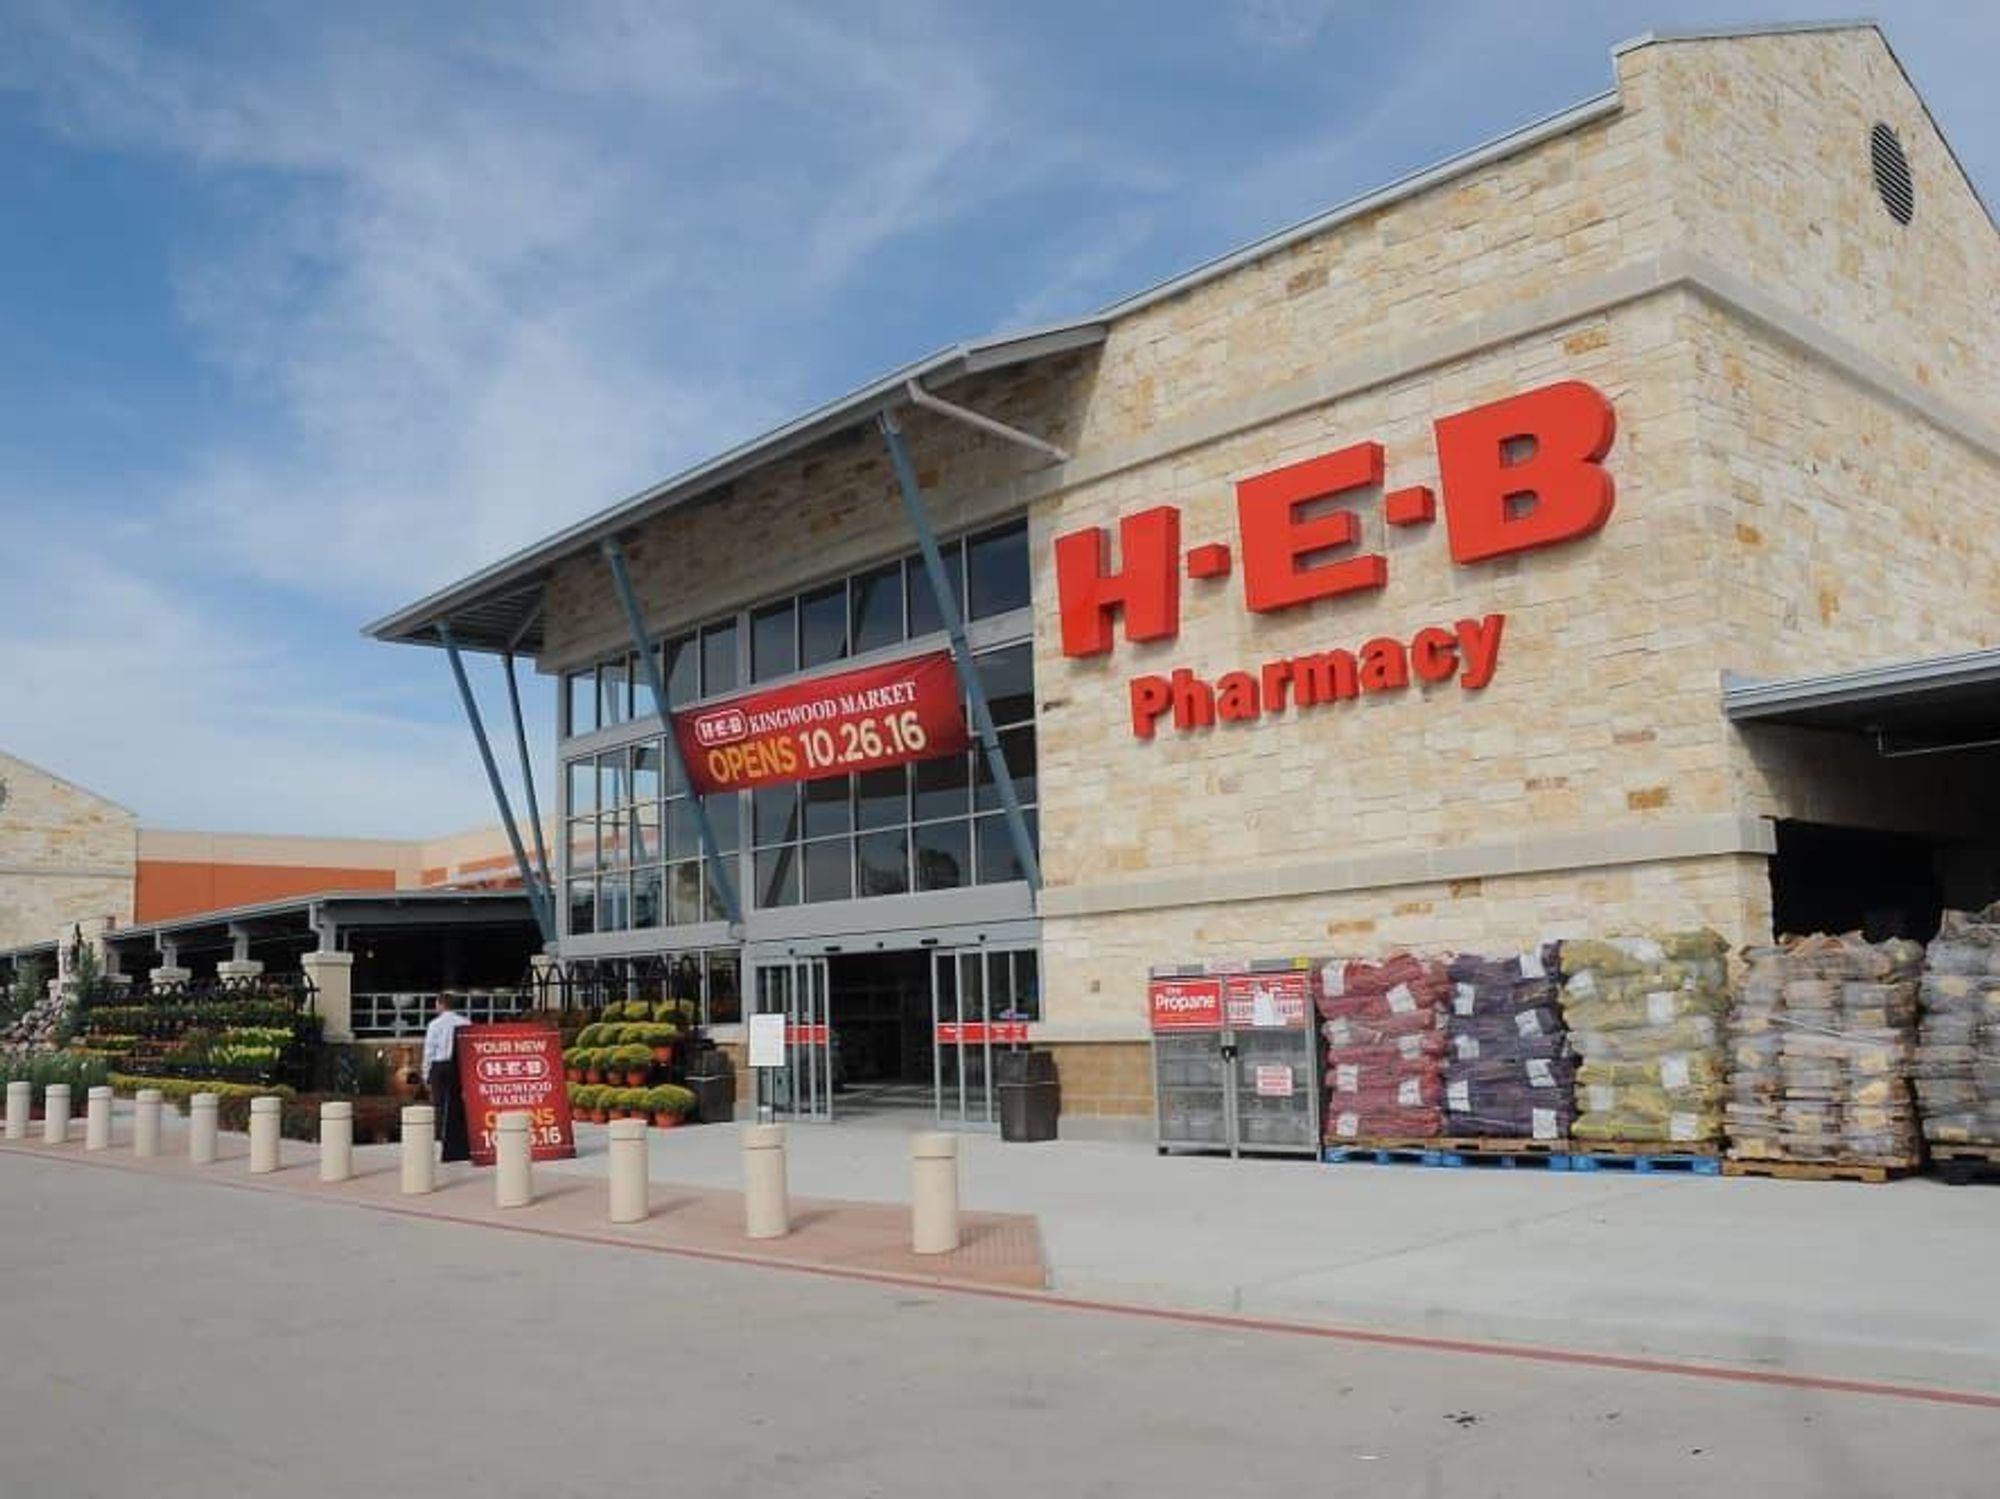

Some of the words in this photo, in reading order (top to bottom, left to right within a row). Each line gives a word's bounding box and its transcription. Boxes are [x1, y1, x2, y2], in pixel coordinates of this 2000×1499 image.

[1056, 381, 1615, 661] H-E-B
[1130, 614, 1505, 739] Pharmacy
[749, 700, 837, 733] KINGWOOD
[839, 681, 917, 716] MARKET
[708, 736, 797, 783] OPENS
[799, 710, 927, 769] 10.26.16
[1155, 993, 1216, 1012] Propane
[473, 1041, 512, 1054] YOUR
[515, 1040, 547, 1053] NEW
[479, 1082, 552, 1095] KINGWOOD
[489, 1093, 544, 1105] MARKET
[485, 1108, 556, 1128] ONS
